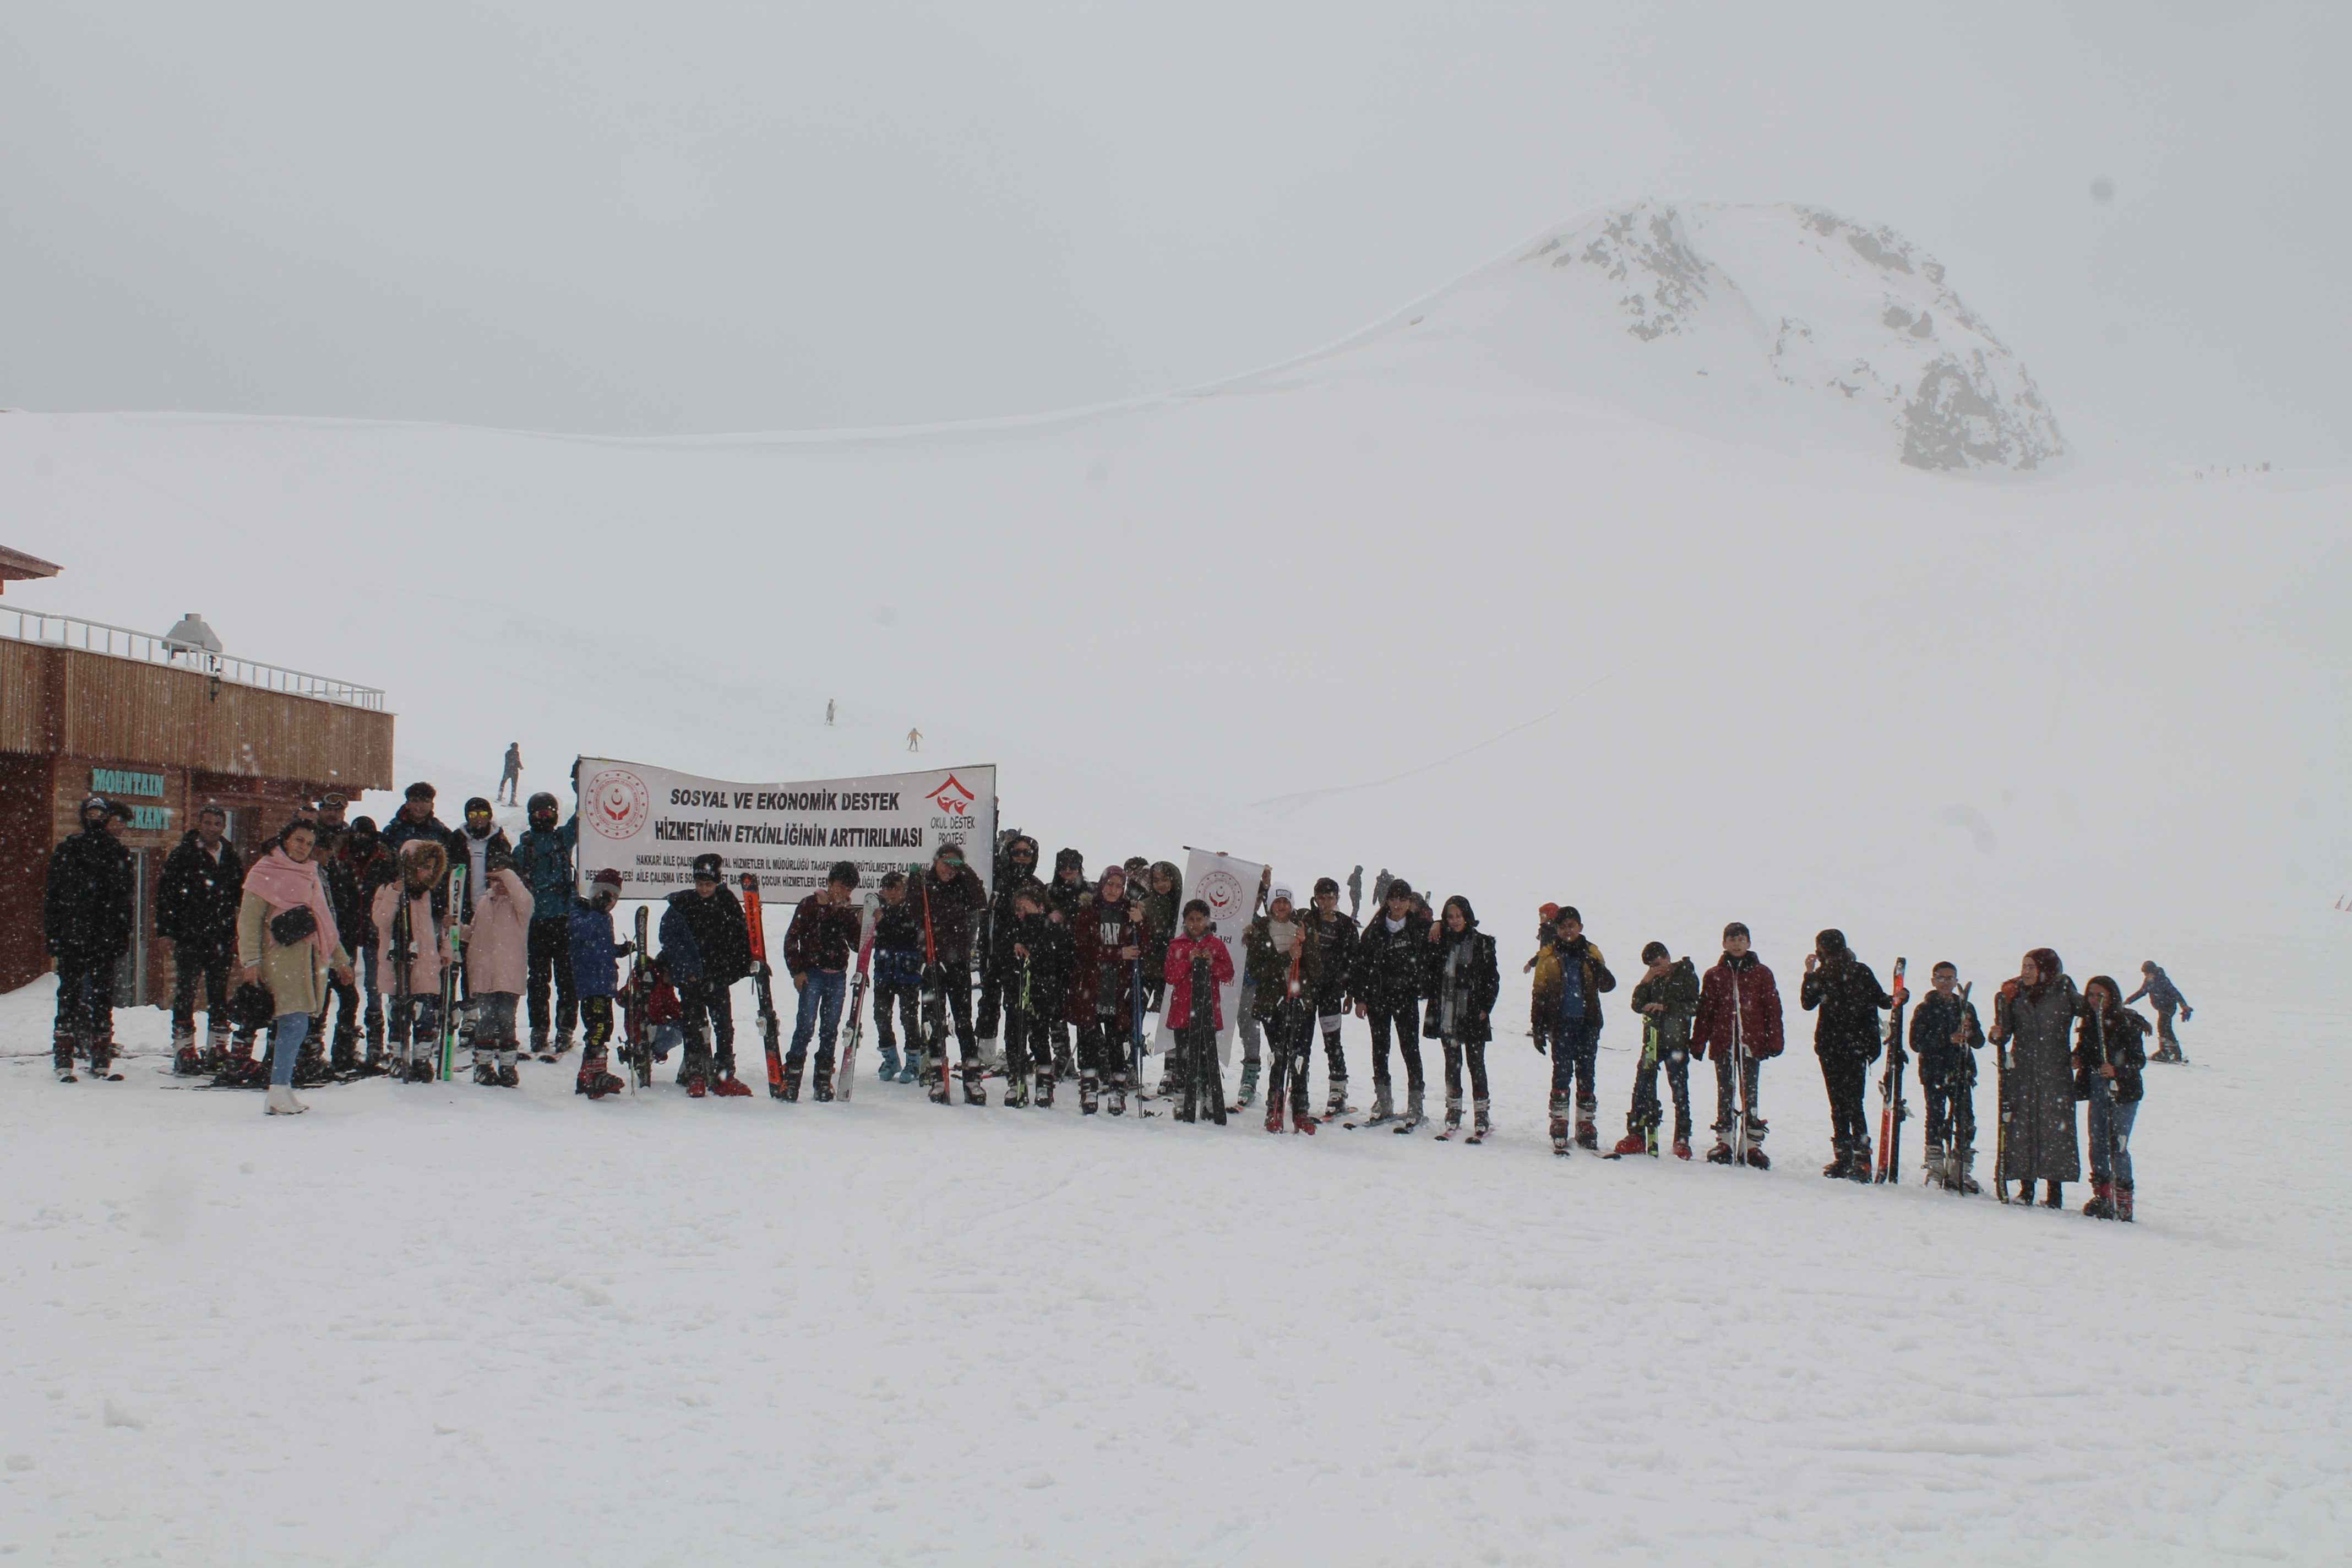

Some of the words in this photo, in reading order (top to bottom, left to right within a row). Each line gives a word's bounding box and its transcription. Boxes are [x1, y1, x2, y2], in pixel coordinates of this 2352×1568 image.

[92, 768, 164, 797] MOUNTAIN
[670, 788, 729, 809] SOSYAL
[734, 792, 753, 809] VE
[756, 788, 838, 811] EKONOMİK
[841, 792, 900, 811] DESTEK
[655, 816, 732, 842] HİZMETİNİN
[735, 822, 827, 847] ETKİNLİĞİNİN
[830, 827, 923, 848] ARTTIRILMASI
[930, 816, 948, 829] OKUL
[950, 816, 975, 829] DESTEK
[636, 853, 662, 865] HAKKARİ
[663, 853, 676, 867] AİLE
[676, 856, 696, 869] ÇALIŞ
[733, 856, 765, 869] HİZMETLER
[766, 857, 771, 870] İL
[772, 857, 809, 870] MÜDÜRLÜĞÜ
[811, 860, 836, 871] TARAFI
[853, 860, 896, 873] ÜRÜTÜLMEKTE
[897, 862, 912, 873] OLA
[636, 869, 649, 882] AİLE
[650, 872, 675, 885] ÇALIŞMA
[676, 873, 683, 883] VE
[761, 875, 781, 888] ÇOCUK
[782, 874, 816, 888] HİZMETLERİ
